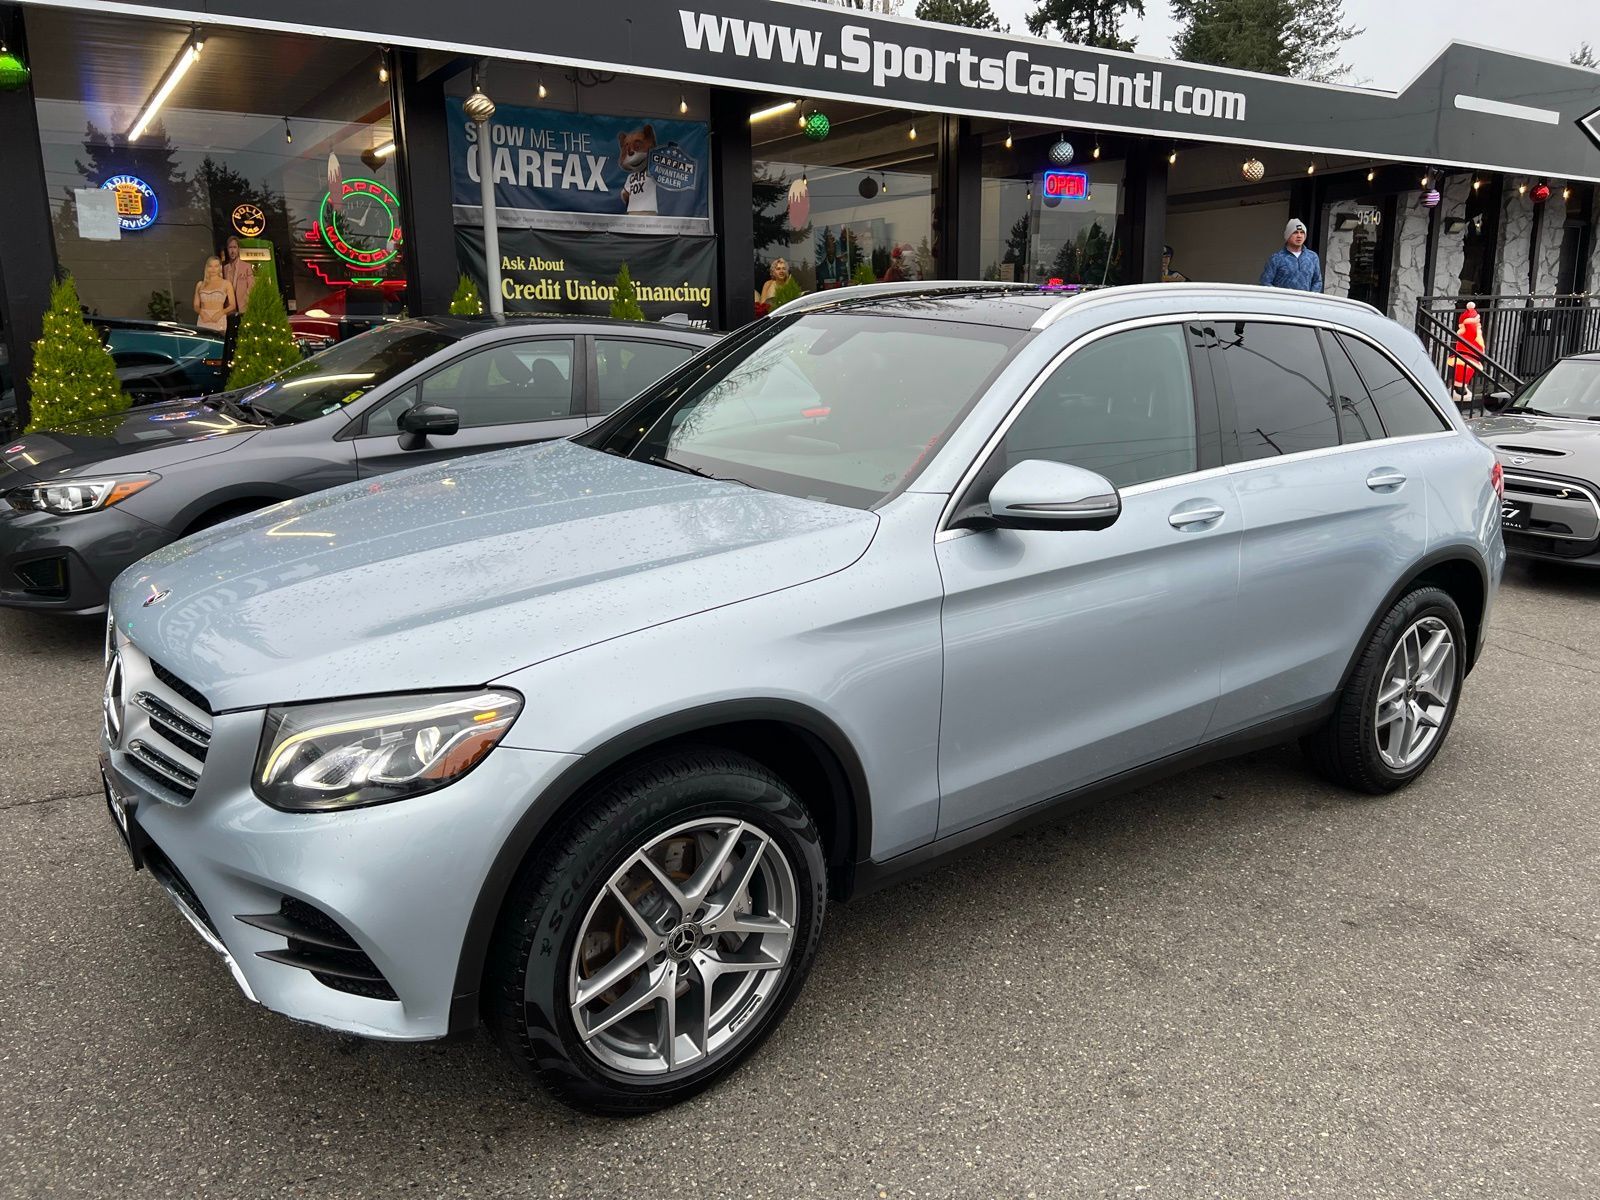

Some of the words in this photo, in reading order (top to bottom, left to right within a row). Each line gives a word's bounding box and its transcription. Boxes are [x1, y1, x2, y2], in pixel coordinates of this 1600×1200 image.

[678, 9, 1247, 121] www.SportsCarsIntl.com
[465, 122, 524, 147] SOW
[530, 128, 556, 150] ME
[560, 131, 591, 153] THE
[653, 155, 694, 174] CARFAX
[630, 172, 645, 184] CAR
[655, 165, 689, 182] ADVANTAGE
[657, 175, 681, 188] DEALER
[103, 176, 152, 198] ADILLAC
[342, 182, 393, 203] APPY
[630, 182, 645, 195] FOX
[1046, 174, 1085, 197] OPEN
[117, 214, 151, 228] ERVICE
[234, 206, 263, 220] POLLY
[241, 226, 260, 234] GAS
[502, 256, 526, 271] Ask
[528, 256, 565, 272] About
[502, 278, 561, 300] Credit
[565, 280, 618, 301] Union
[630, 281, 711, 307] inancing
